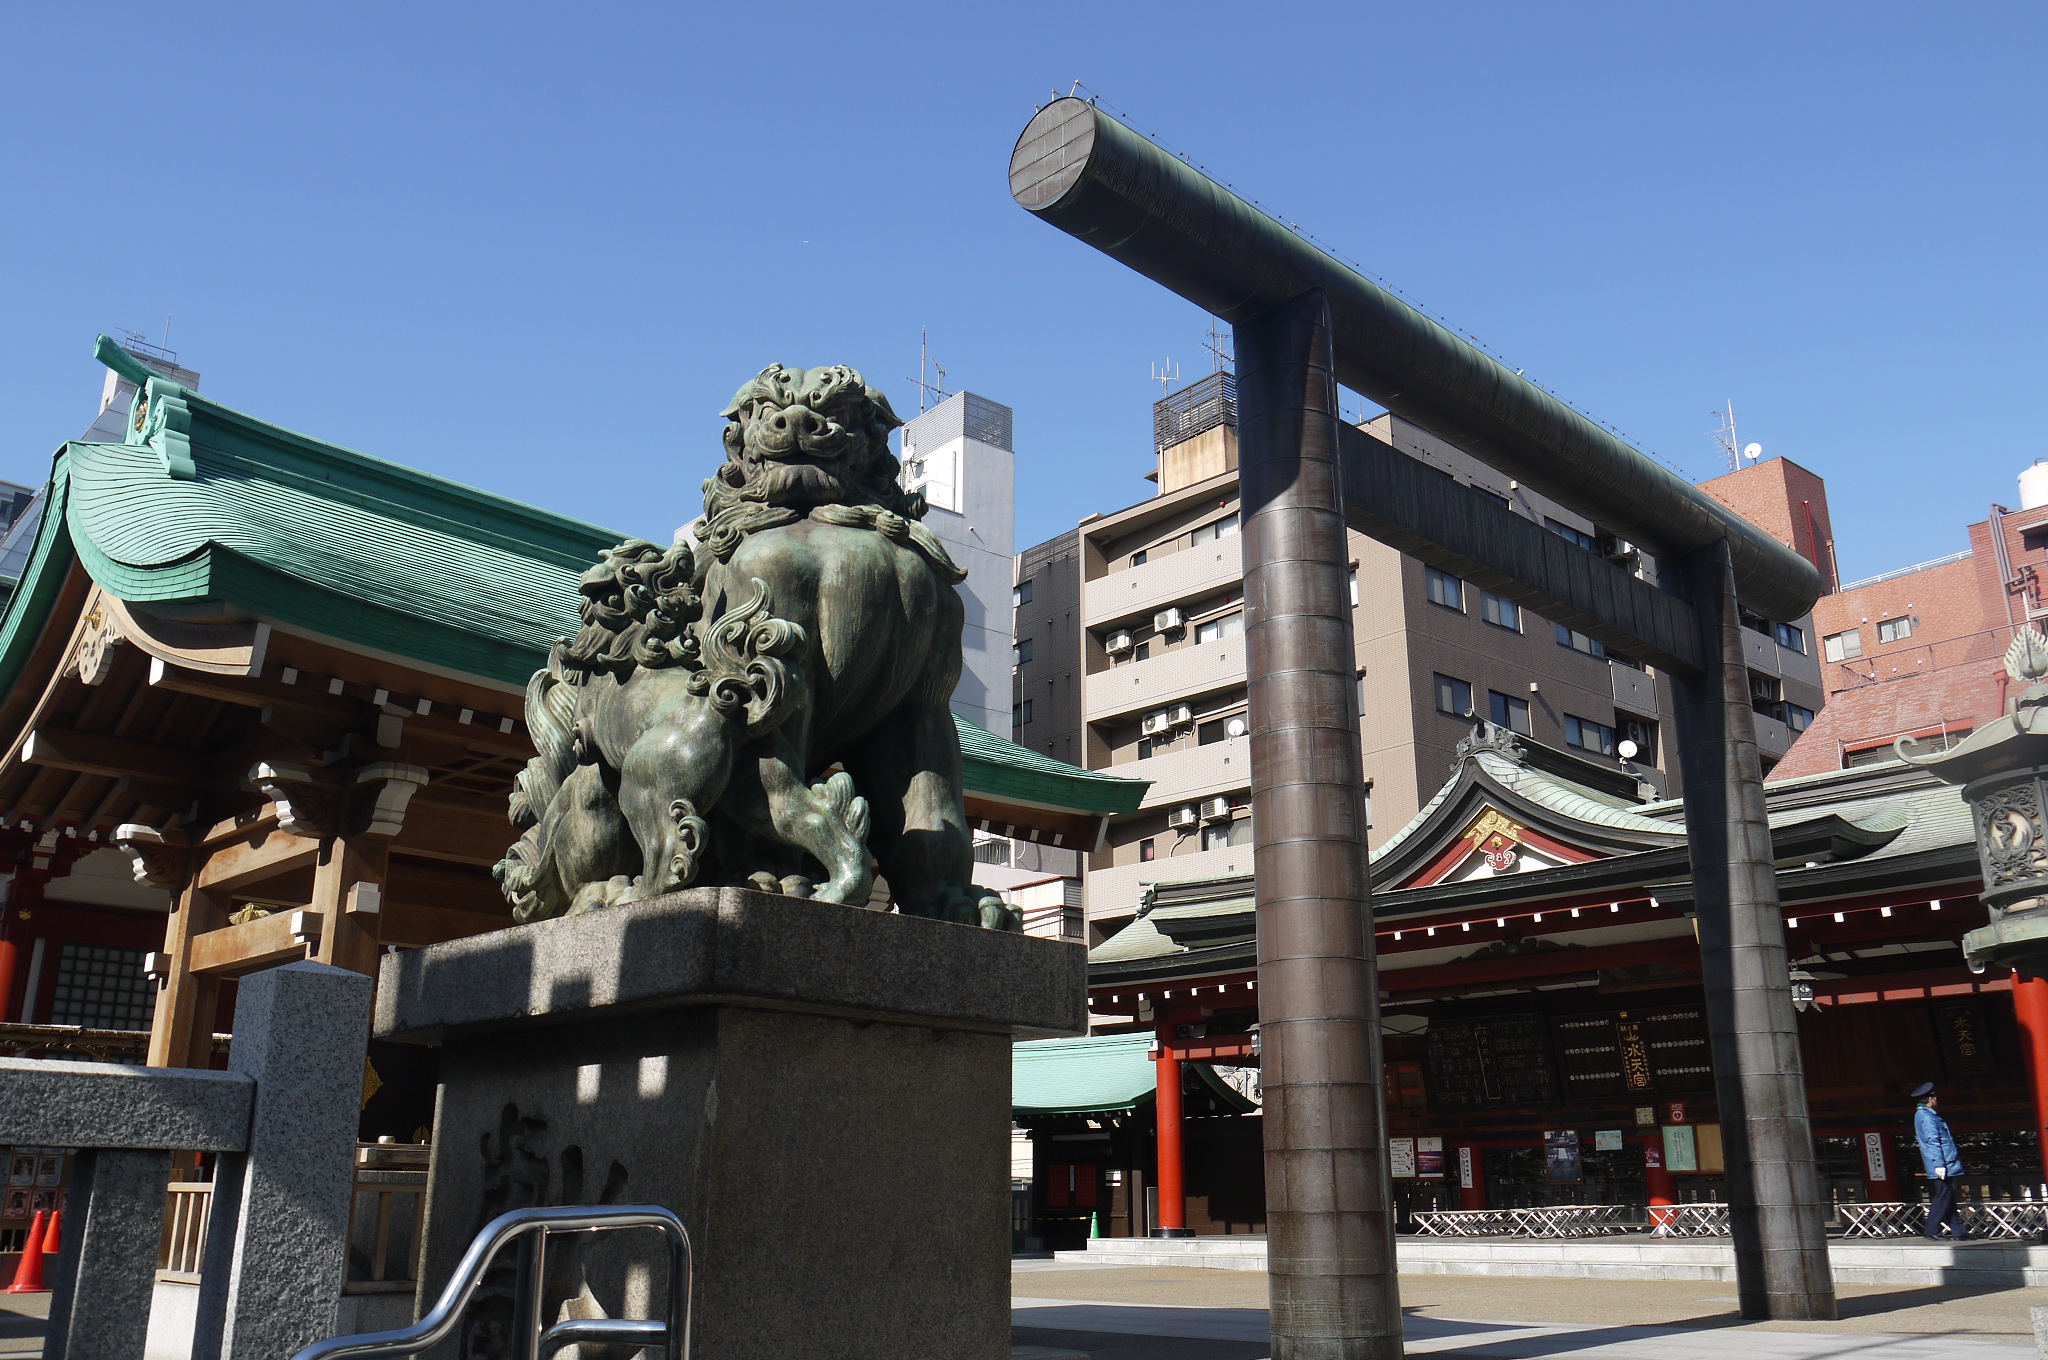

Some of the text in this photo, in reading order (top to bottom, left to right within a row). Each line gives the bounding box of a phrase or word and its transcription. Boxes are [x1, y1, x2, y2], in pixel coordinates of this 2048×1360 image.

[1953, 1017, 1976, 1056] 水天宮
[1627, 1043, 1647, 1087] 水天宮
